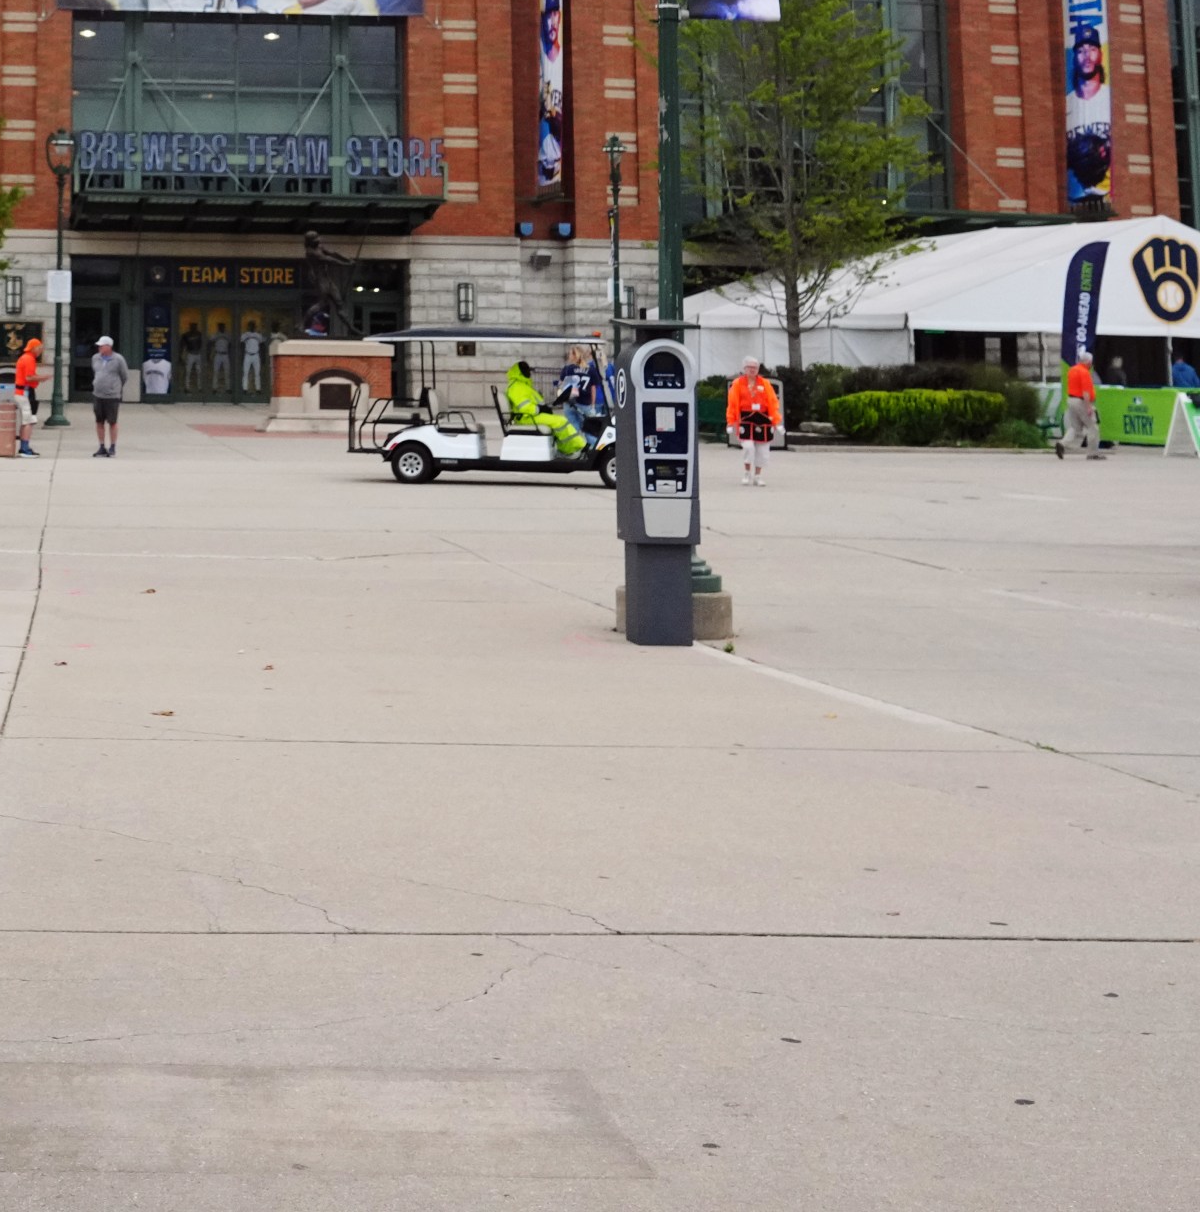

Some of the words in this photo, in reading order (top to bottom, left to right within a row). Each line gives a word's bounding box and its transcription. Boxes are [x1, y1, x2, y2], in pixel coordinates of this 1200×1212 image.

[80, 131, 228, 173] BREWERS
[246, 135, 329, 174] TEAM
[345, 137, 443, 177] STORE
[179, 266, 227, 283] TEAM
[240, 268, 294, 284] STORE
[1123, 414, 1153, 436] ENTRY
